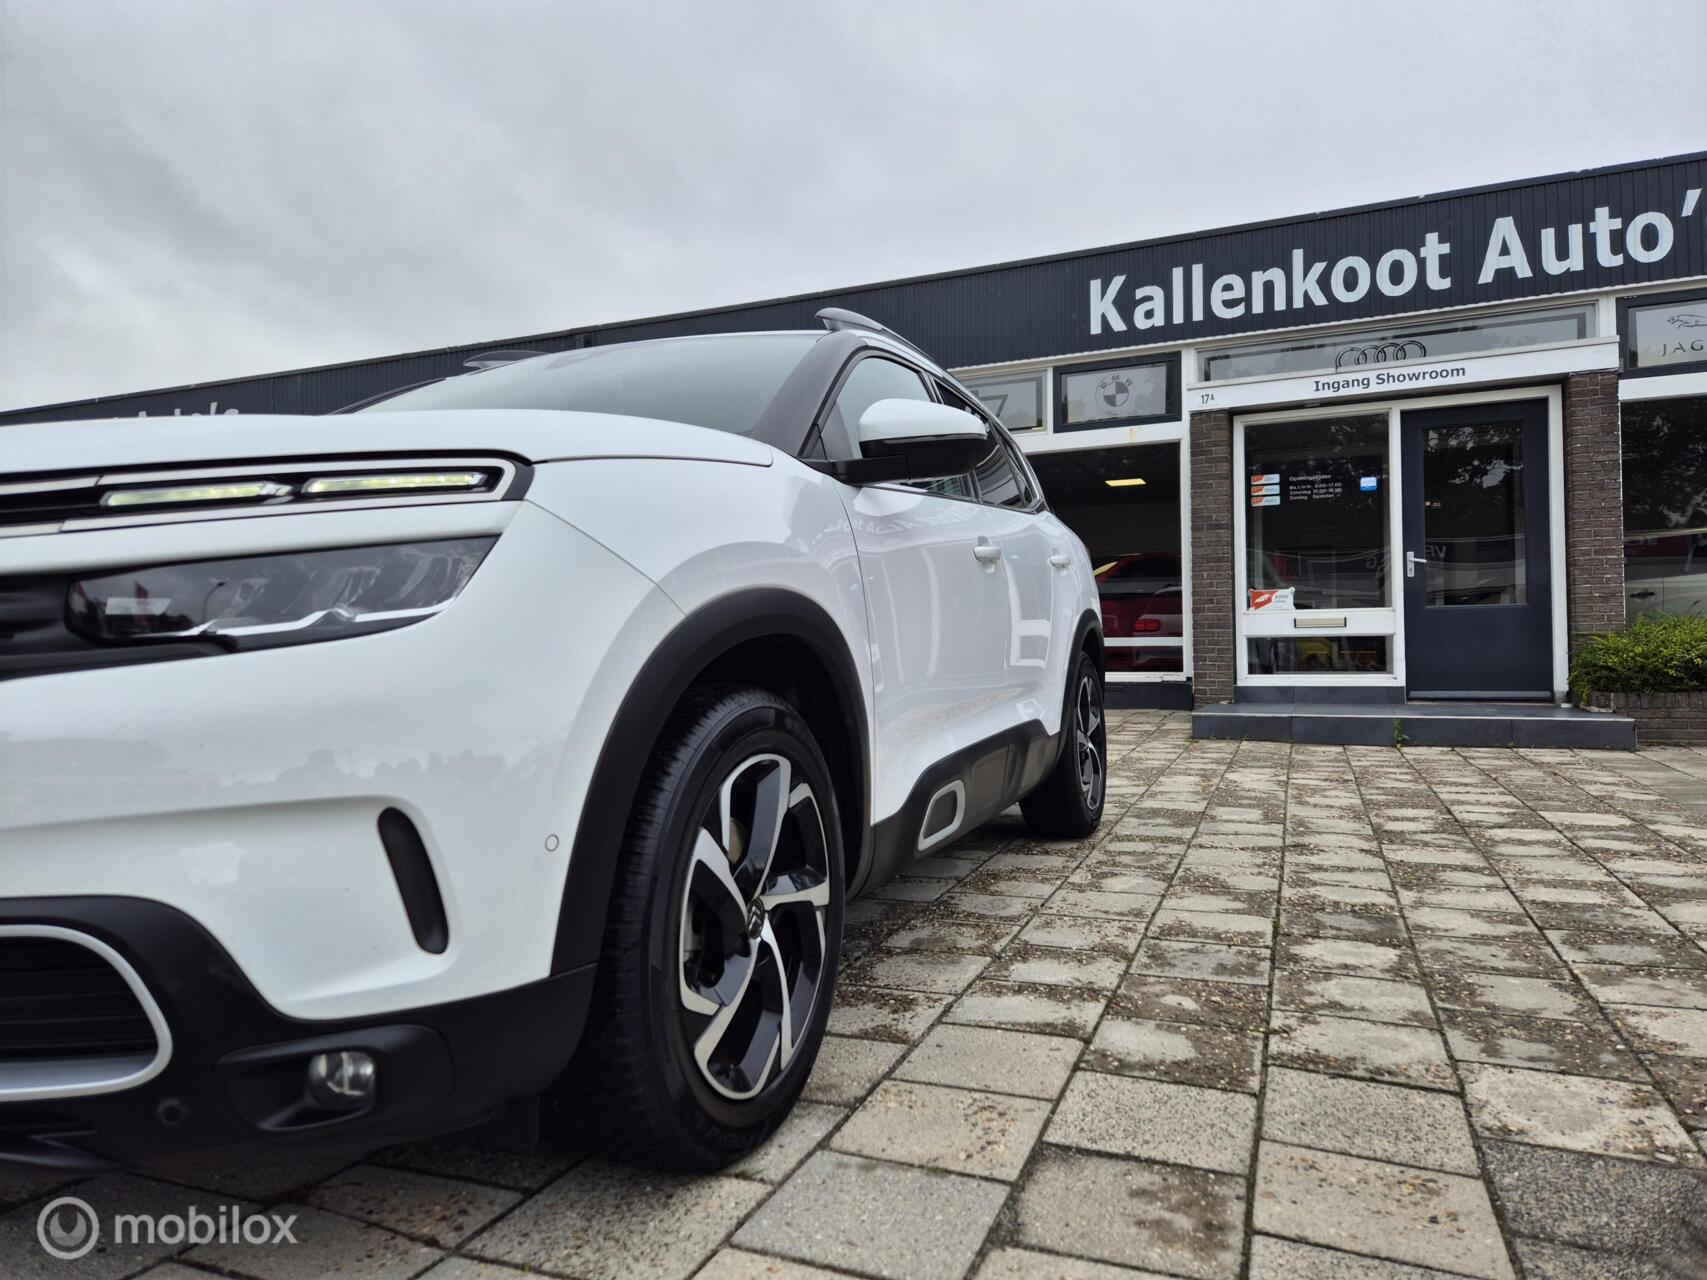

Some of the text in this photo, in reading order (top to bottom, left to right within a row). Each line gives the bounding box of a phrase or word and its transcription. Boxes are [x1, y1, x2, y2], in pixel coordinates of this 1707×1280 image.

[1089, 187, 1707, 335] Kallenkoot Auto'
[1098, 374, 1134, 389] BMW
[1313, 366, 1466, 393] Ingang Showroom
